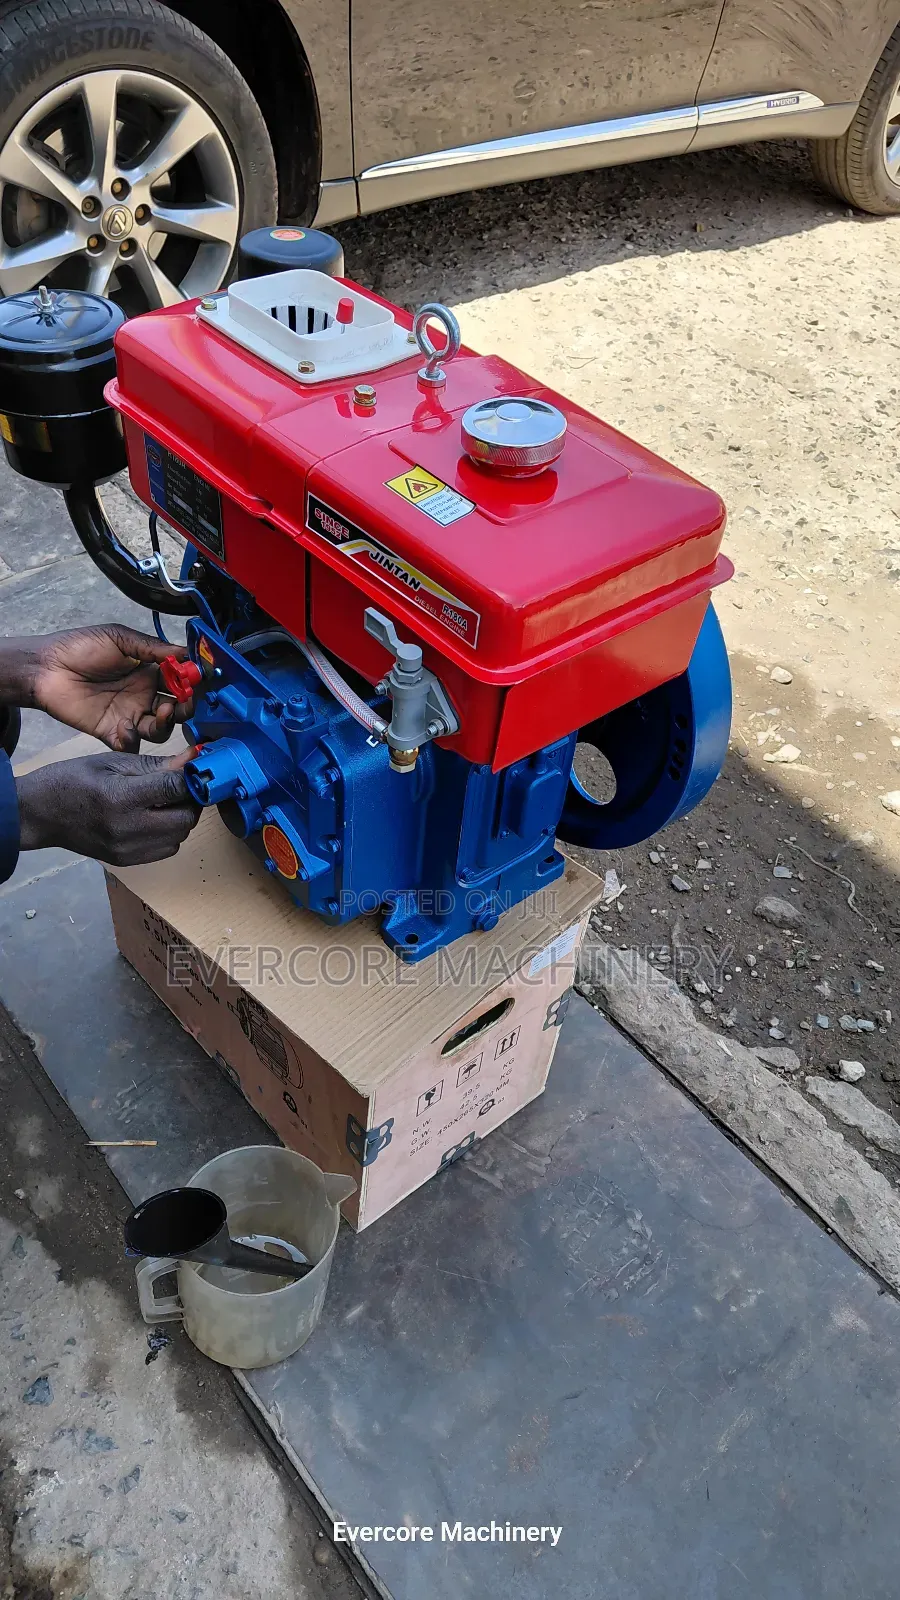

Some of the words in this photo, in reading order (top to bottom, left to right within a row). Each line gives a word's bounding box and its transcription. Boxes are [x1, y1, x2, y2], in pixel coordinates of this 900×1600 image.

[770, 97, 797, 108] HYBRID
[315, 508, 349, 539] SINCE
[369, 550, 421, 591] JINTAN
[415, 595, 438, 617] DIESEL
[440, 614, 467, 637] ENGINE
[442, 603, 468, 632] R180A
[500, 1068, 512, 1080] KG
[502, 1058, 515, 1070] KG
[409, 1136, 433, 1156] SIZE:
